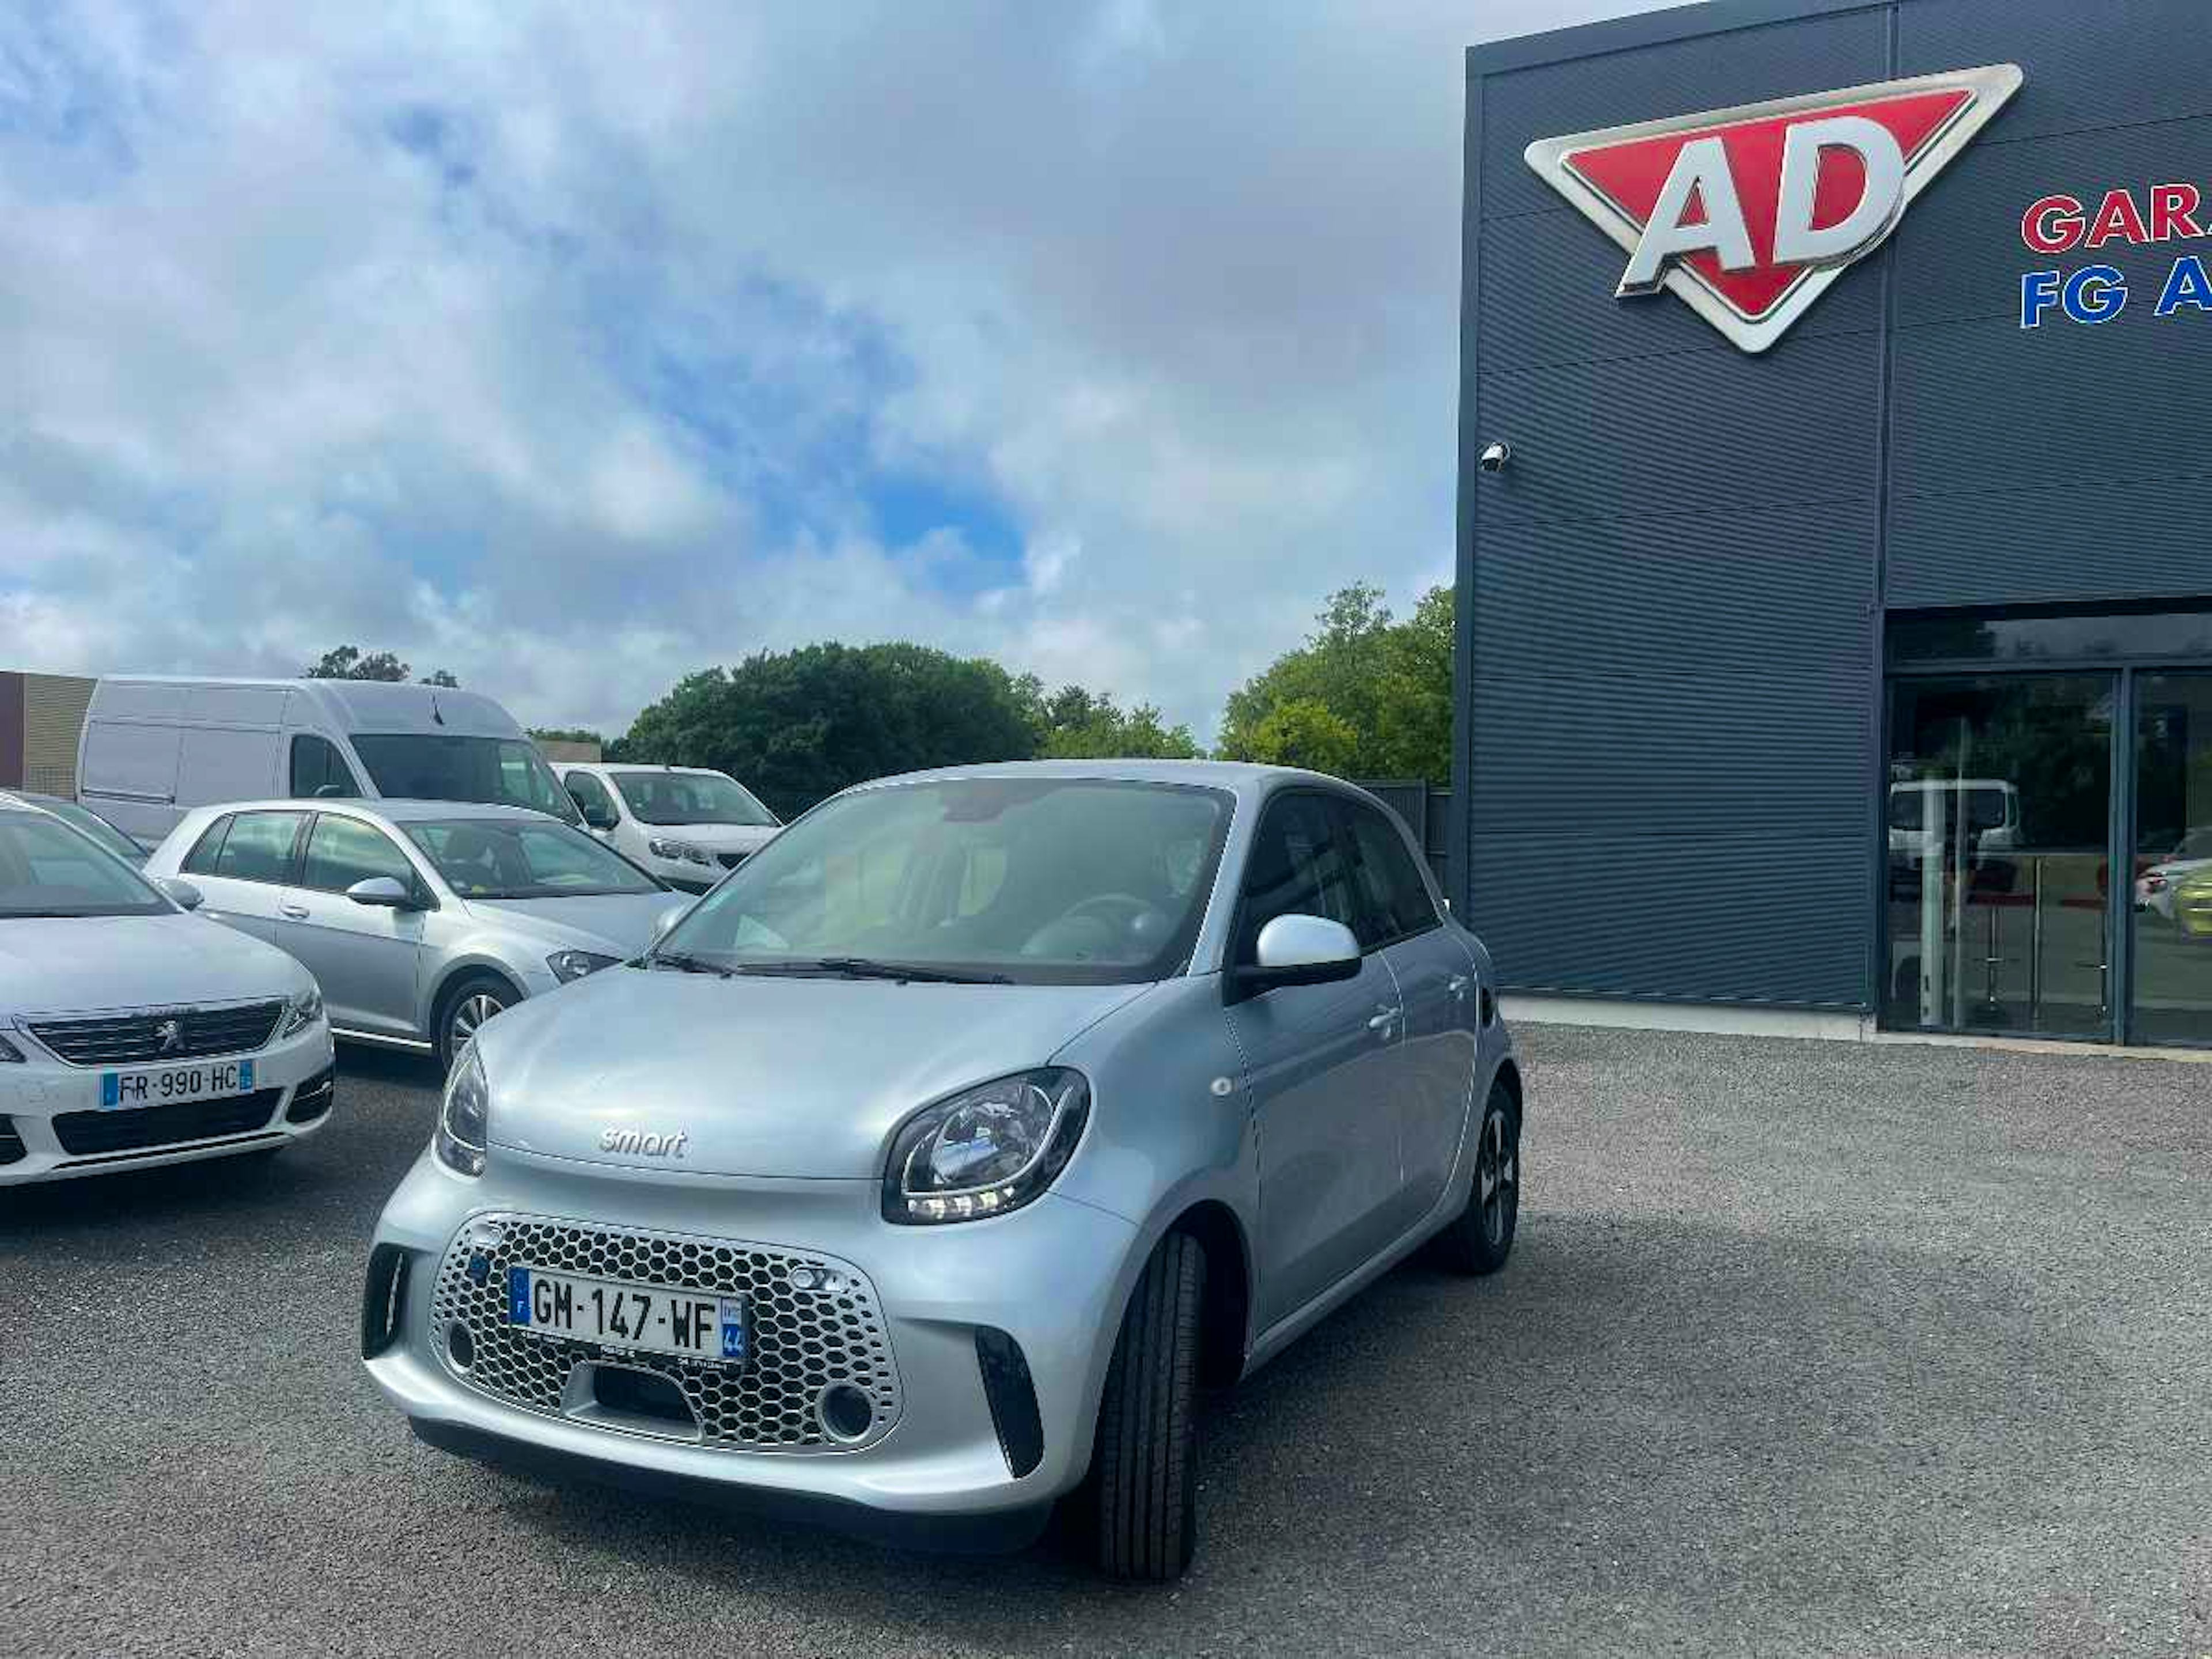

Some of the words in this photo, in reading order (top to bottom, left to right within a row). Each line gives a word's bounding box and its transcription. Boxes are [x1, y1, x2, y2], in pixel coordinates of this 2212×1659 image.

[1616, 115, 1907, 297] AD
[2021, 183, 2212, 253] GAR
[2020, 264, 2129, 329] FG
[600, 1127, 688, 1158] smart
[517, 1300, 525, 1313] F
[534, 1279, 715, 1349] GM-147-WF
